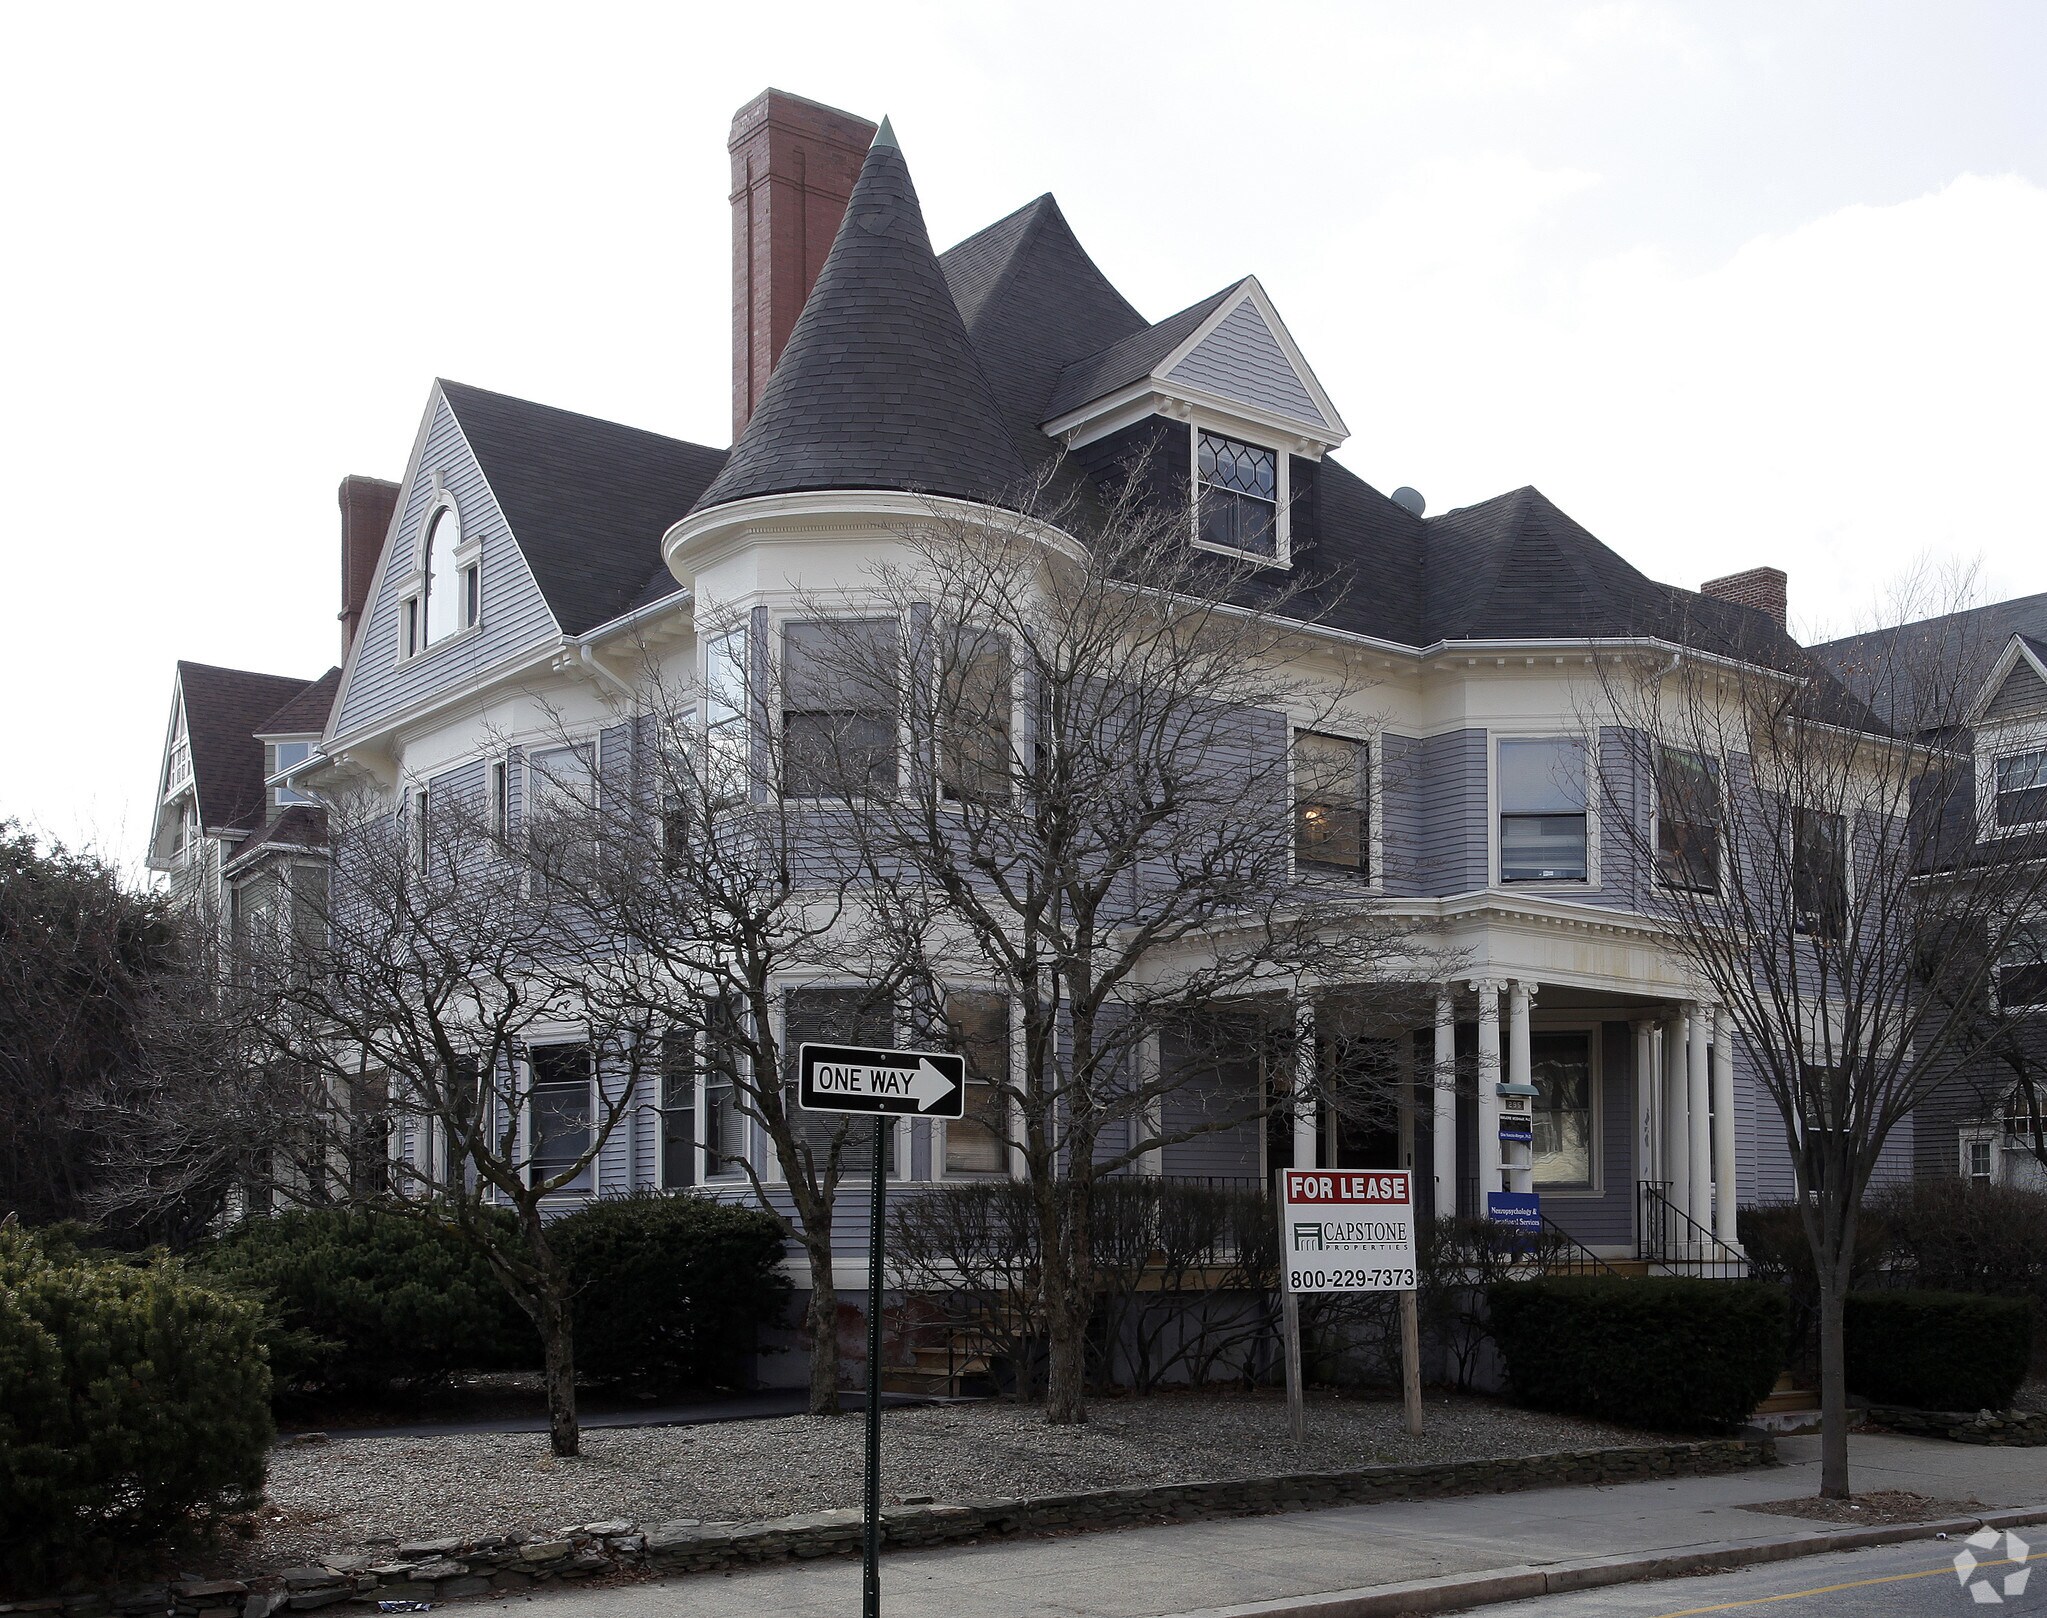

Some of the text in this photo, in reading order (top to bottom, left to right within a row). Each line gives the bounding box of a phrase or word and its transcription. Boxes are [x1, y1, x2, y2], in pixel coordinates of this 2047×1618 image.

[818, 1066, 915, 1095] ONE WAY
[1290, 1176, 1406, 1199] FOR LEASE
[1491, 1206, 1532, 1216] Neuropsychology
[1519, 1217, 1540, 1226] Services
[1323, 1222, 1407, 1241] CAPSTONE
[1290, 1269, 1414, 1288] 800-229-7373
